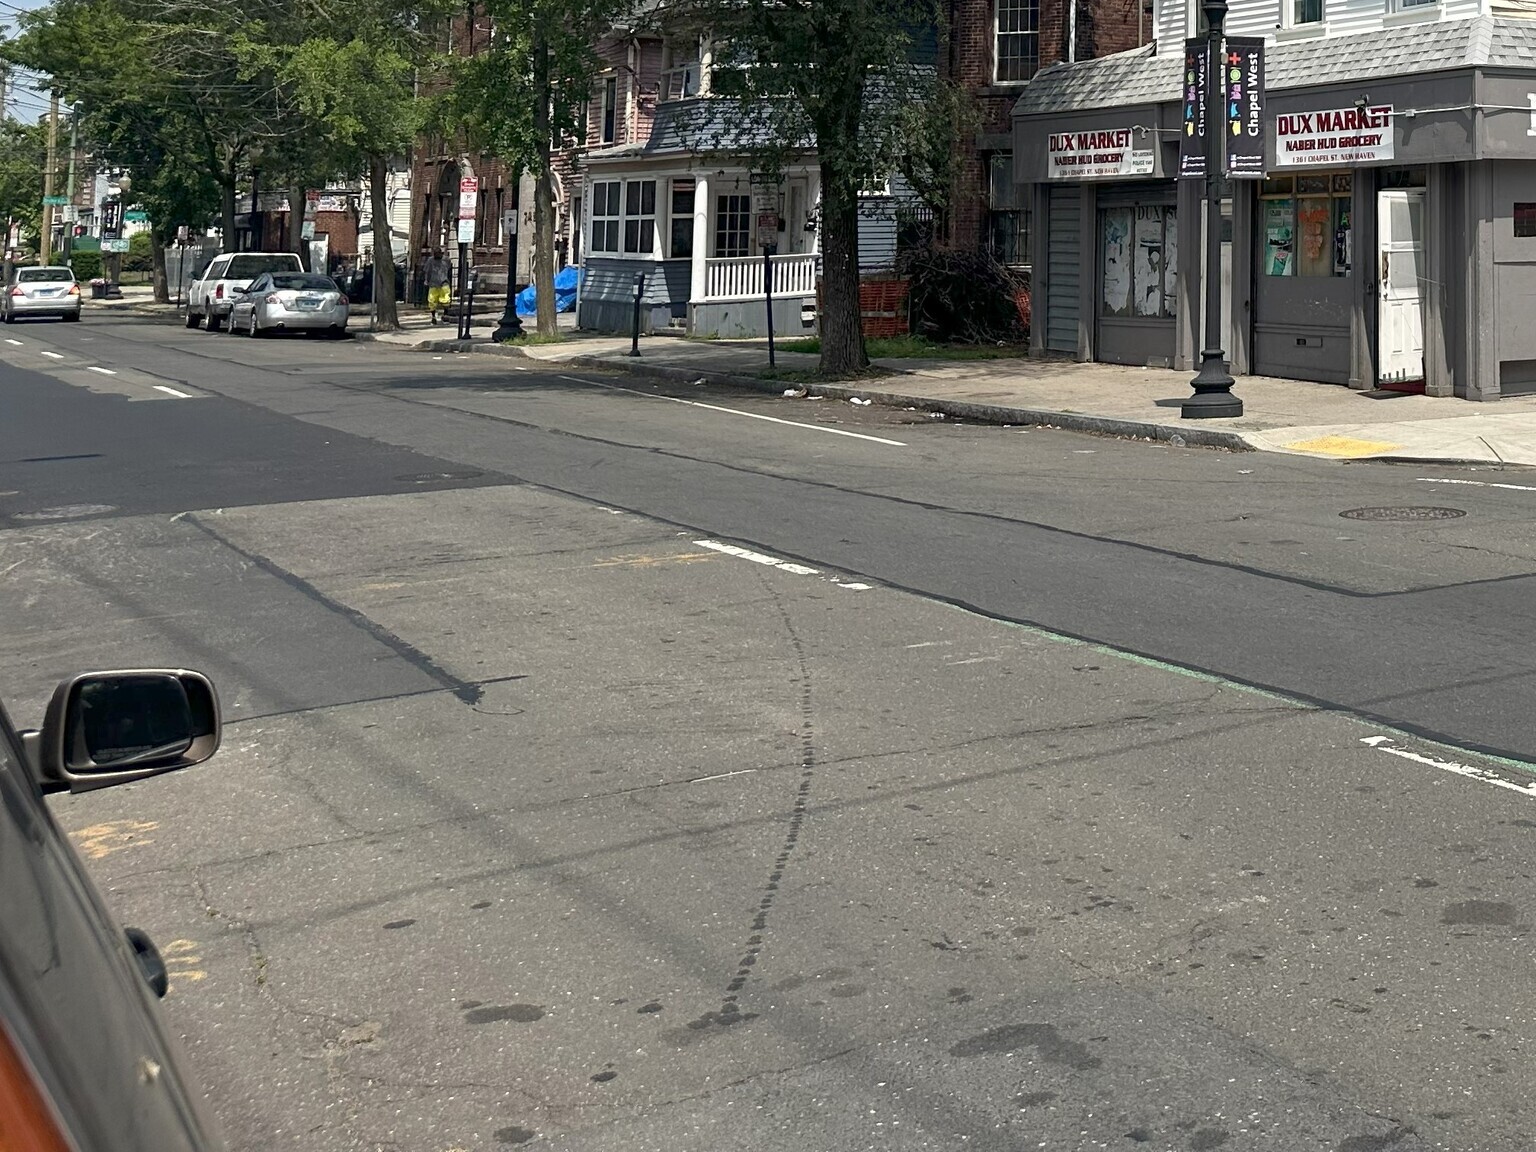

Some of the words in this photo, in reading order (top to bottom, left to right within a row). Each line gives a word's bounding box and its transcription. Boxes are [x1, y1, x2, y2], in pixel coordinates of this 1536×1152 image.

[1247, 53, 1258, 88] West
[1198, 90, 1206, 136] Chapel
[1247, 90, 1261, 136] Chapel
[1278, 114, 1313, 136] DUX
[1316, 106, 1392, 133] MARKET
[1050, 134, 1075, 152] DUX
[1078, 129, 1131, 150] MARKET
[1286, 139, 1316, 152] NABER
[1317, 137, 1336, 149] HUD
[1339, 134, 1383, 148] GROCERY
[1055, 155, 1077, 166] NABER
[1078, 155, 1092, 165] HUD
[1093, 153, 1124, 163] GROCERY
[1341, 153, 1354, 161] NEW
[1138, 206, 1160, 220] DUX
